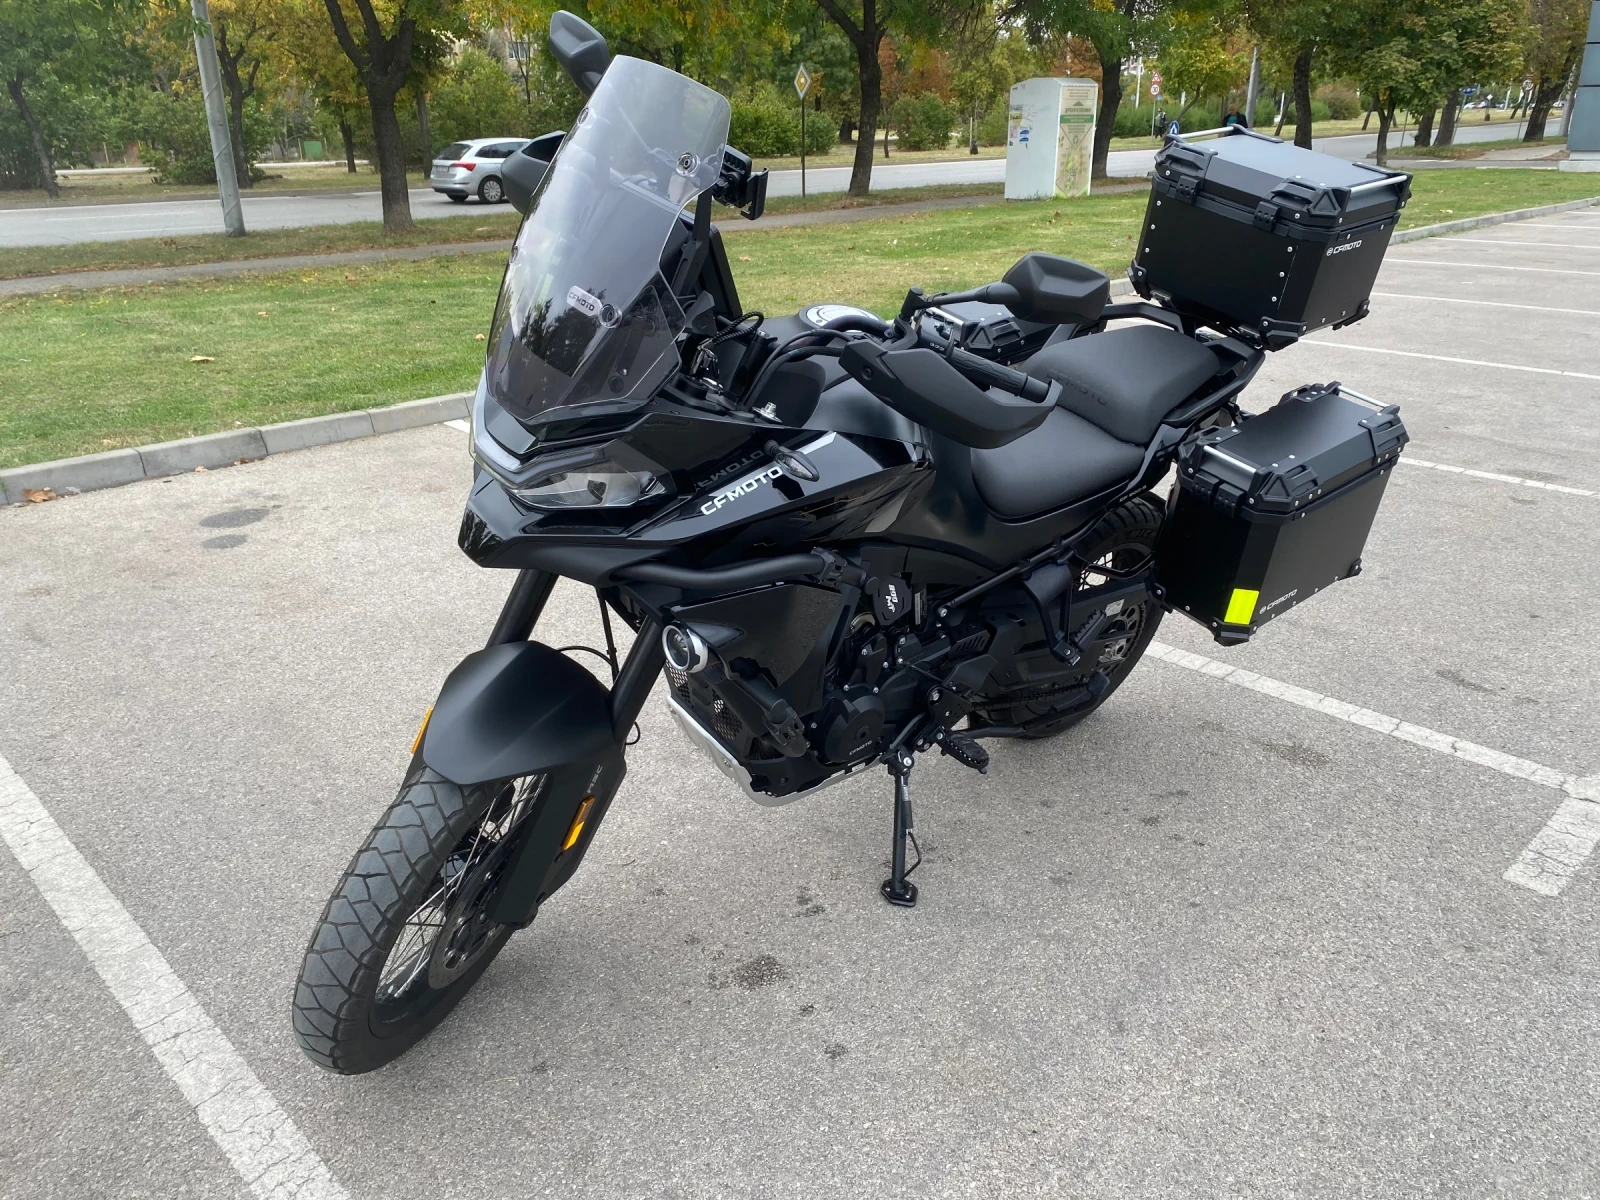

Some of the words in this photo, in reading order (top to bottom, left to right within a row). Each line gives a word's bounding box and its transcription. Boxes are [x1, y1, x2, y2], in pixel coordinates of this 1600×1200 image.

[1333, 239, 1362, 254] CFMOTO
[568, 291, 595, 312] CFMOTO
[700, 466, 783, 516] CFMOTO
[1266, 588, 1298, 610] CFMOTO
[849, 740, 873, 756] CFMOTO
